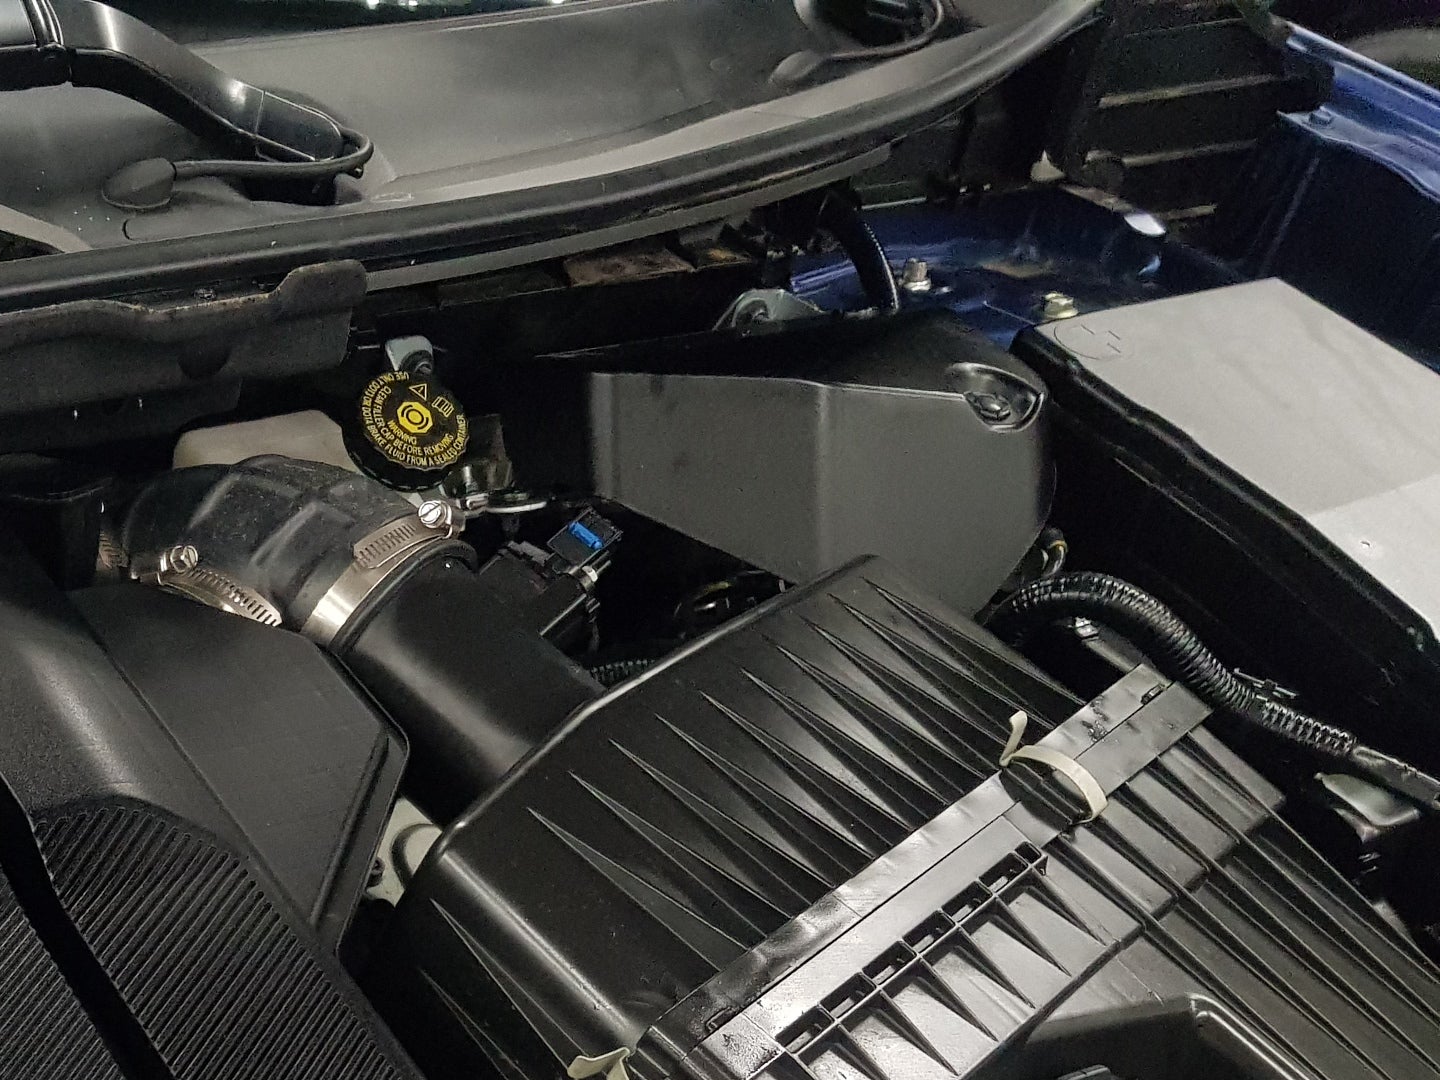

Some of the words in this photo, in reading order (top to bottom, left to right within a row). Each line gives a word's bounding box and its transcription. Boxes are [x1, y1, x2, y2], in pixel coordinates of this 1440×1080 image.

[367, 424, 388, 447] BRAKE
[384, 443, 406, 460] FLUID
[406, 454, 428, 466] FROM
[433, 446, 458, 464] SEALED
[453, 413, 468, 450] CONTAINER
[373, 404, 385, 428] FILLER
[380, 426, 395, 441] CAP
[392, 439, 423, 456] BEFORE
[423, 433, 454, 455] REMOVING
[387, 419, 418, 445] WARNING
